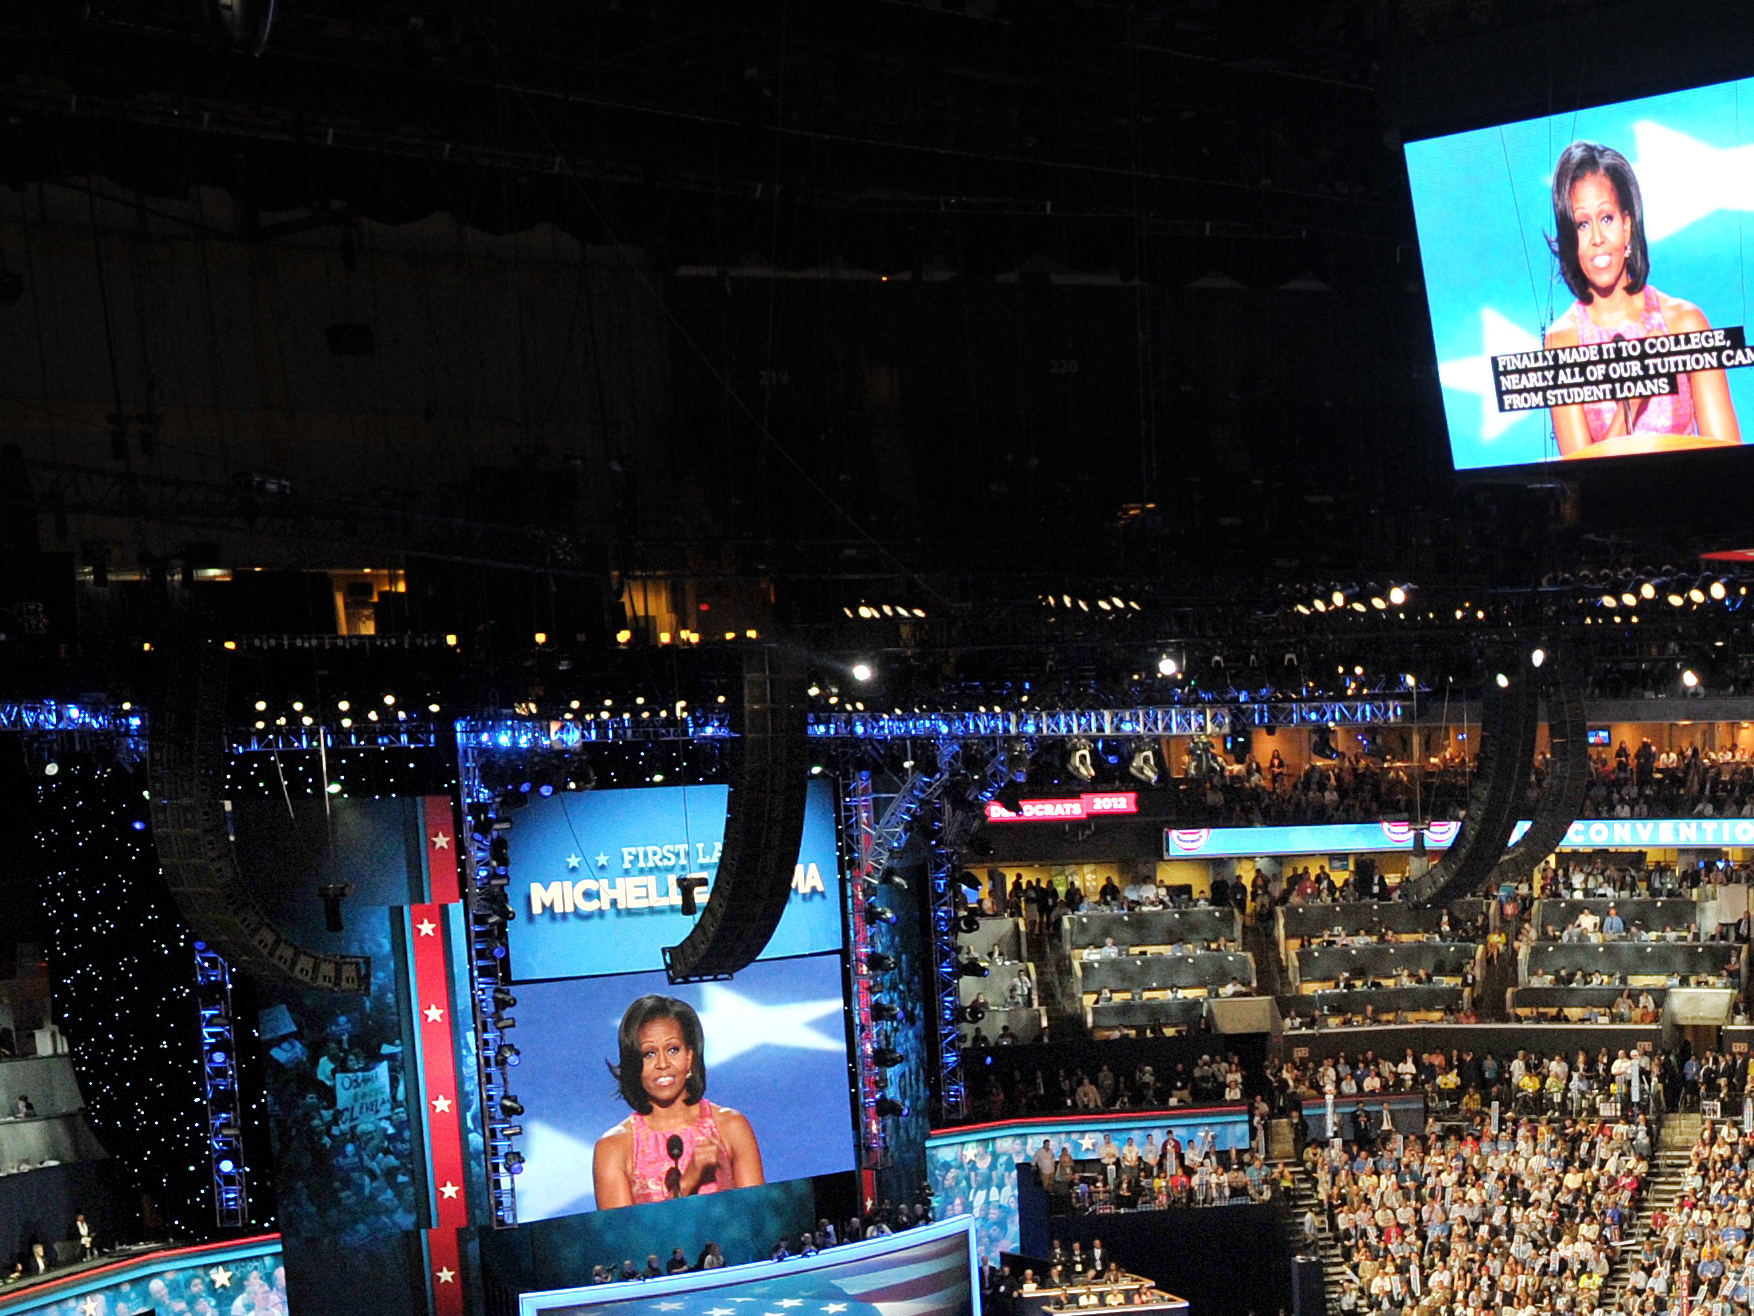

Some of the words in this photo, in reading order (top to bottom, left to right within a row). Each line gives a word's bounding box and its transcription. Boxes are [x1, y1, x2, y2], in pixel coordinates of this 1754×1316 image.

[1497, 350, 1555, 371] FINALLY
[1558, 346, 1599, 363] MADE
[1602, 343, 1617, 359] IT
[1619, 340, 1641, 357] TO
[1644, 330, 1731, 354] COLLEGE,
[758, 370, 790, 386] 219
[1499, 371, 1556, 391] NEARLY
[1558, 368, 1584, 385] ALL
[1586, 365, 1606, 381] OF
[1609, 361, 1645, 379] OUR
[1645, 352, 1718, 375] TUITION
[1503, 391, 1545, 409] FROM
[1546, 384, 1615, 407] STUDENT
[1616, 378, 1670, 399] LOANS
[1093, 797, 1127, 810] 2012
[621, 843, 688, 869] FIRST
